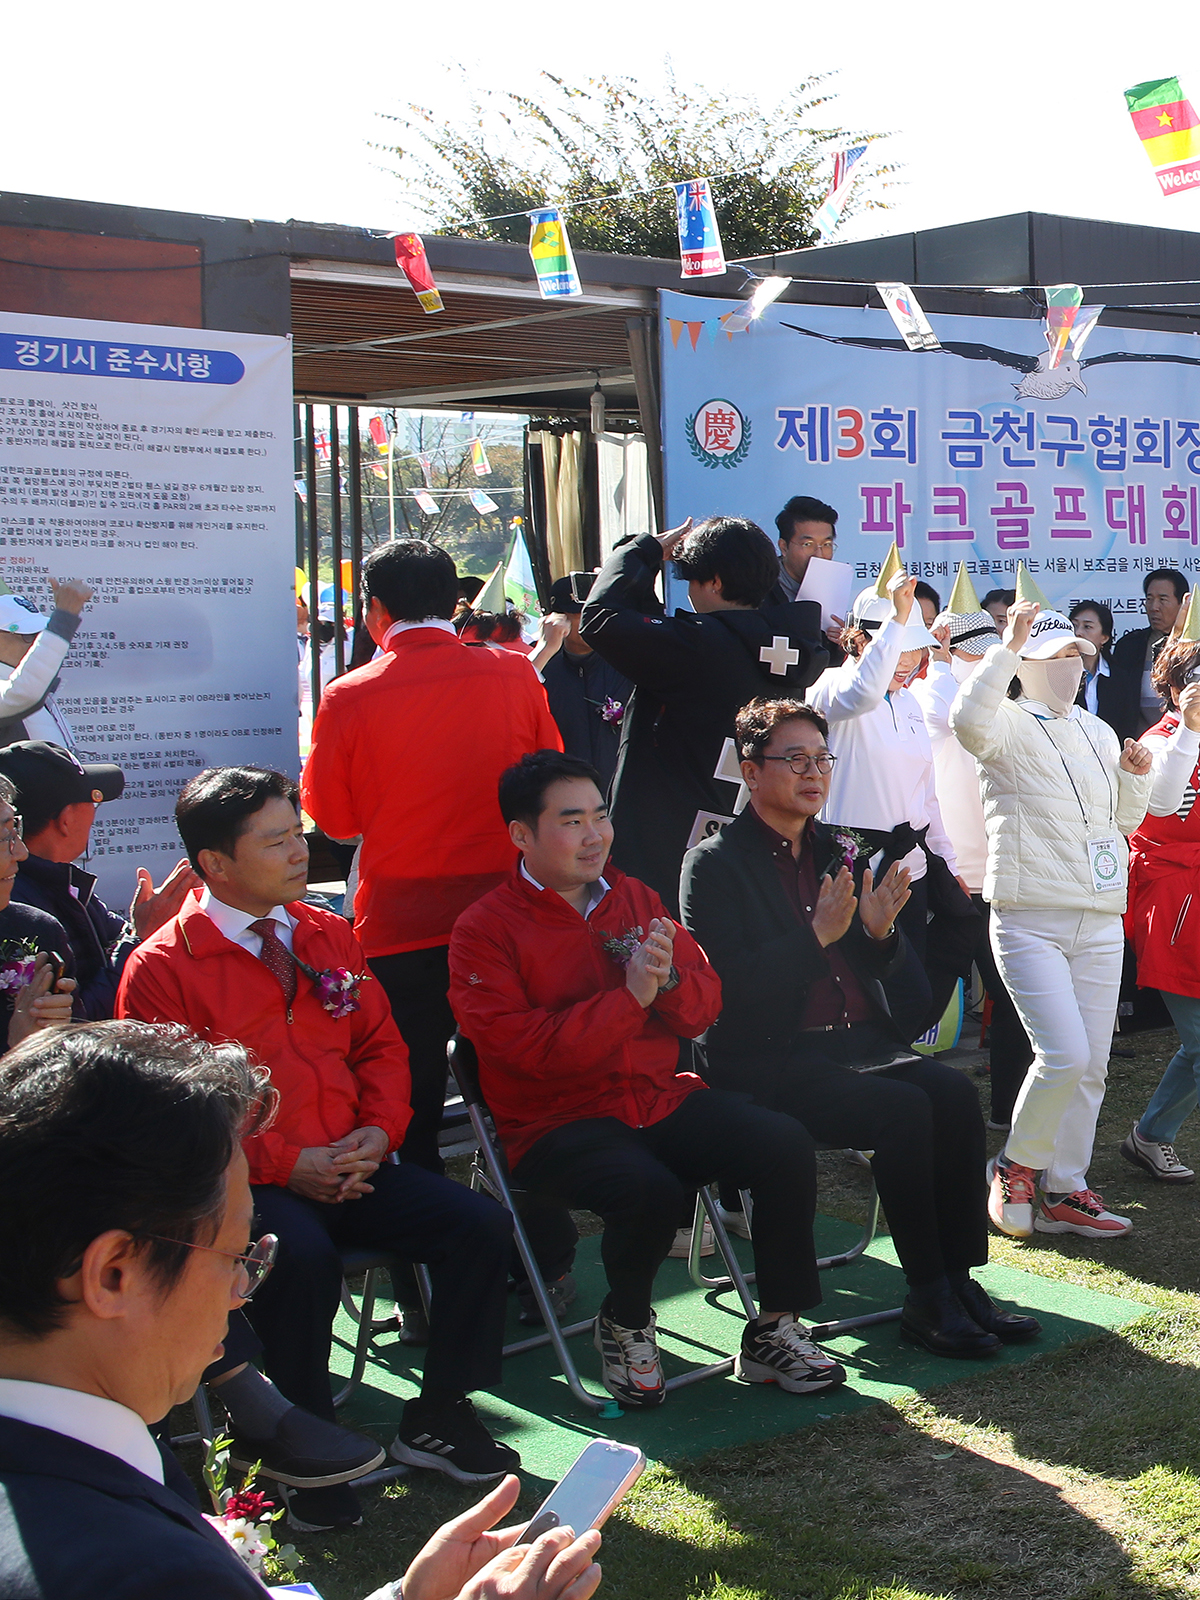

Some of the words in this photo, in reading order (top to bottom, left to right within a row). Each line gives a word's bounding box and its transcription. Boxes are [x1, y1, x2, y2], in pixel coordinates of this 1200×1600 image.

[15, 340, 96, 371] 경기시
[106, 348, 212, 379] 준수사항
[62, 401, 78, 410] 샷건
[81, 402, 97, 410] 방식
[20, 409, 36, 417] 지정
[40, 410, 64, 418] 홀에서
[67, 412, 103, 420] 시작한다.
[6, 418, 28, 426] 2부로
[31, 419, 56, 428] 조장과
[59, 421, 83, 429] 조원이
[87, 422, 118, 431] 작성하여
[151, 426, 182, 434] 경기자의
[185, 427, 199, 435] 확인
[245, 430, 276, 439] 제출한다.
[704, 409, 737, 453] 慶
[18, 428, 34, 436] 상이
[59, 430, 74, 438] 해당
[78, 431, 93, 439] 조는
[97, 432, 120, 440] 실격이
[776, 405, 919, 466] 제3회
[52, 440, 75, 448] 해결을
[79, 441, 111, 450] 원칙으로
[147, 444, 170, 452] 해결시
[173, 446, 211, 454] 집행부에서
[79, 469, 102, 478] 규정에
[105, 470, 132, 479] 따른다.
[68, 479, 84, 487] 공이
[200, 484, 228, 492] 6개월간
[231, 485, 245, 493] 입장
[10, 487, 25, 495] 배치
[52, 489, 68, 497] 발생
[101, 491, 116, 499] 진행
[163, 502, 187, 510] PAR의
[221, 504, 243, 512] 타수는
[109, 520, 133, 528] 코로나
[27, 528, 51, 536] 이내에
[10, 538, 52, 546] 동반자에게
[118, 540, 141, 548] 하거나
[7, 566, 49, 574] 가위바위보
[1044, 557, 1079, 573] 서울시
[1083, 557, 1129, 573] 보조금을
[1133, 557, 1154, 572] 지원
[1158, 557, 1179, 571] 받는
[204, 587, 227, 595] 공부터
[100, 632, 116, 640] 제출
[111, 696, 143, 704] 알려주는
[179, 695, 194, 703] 공이
[197, 694, 230, 702] OB라인을
[101, 706, 116, 714] 없는
[119, 705, 135, 713] 경우
[120, 723, 135, 731] 인정
[108, 733, 131, 742] 알려야
[195, 729, 229, 738] 1명이라도
[232, 728, 250, 736] OB로
[253, 727, 282, 736] 인정하면
[165, 750, 198, 758] 처치한다.
[124, 762, 140, 770] 하는
[106, 818, 135, 826] 3분이상
[138, 816, 169, 825] 경과하면
[108, 827, 139, 836] 실격처리
[127, 845, 158, 853] 동반자가
[161, 842, 176, 851] 공을
